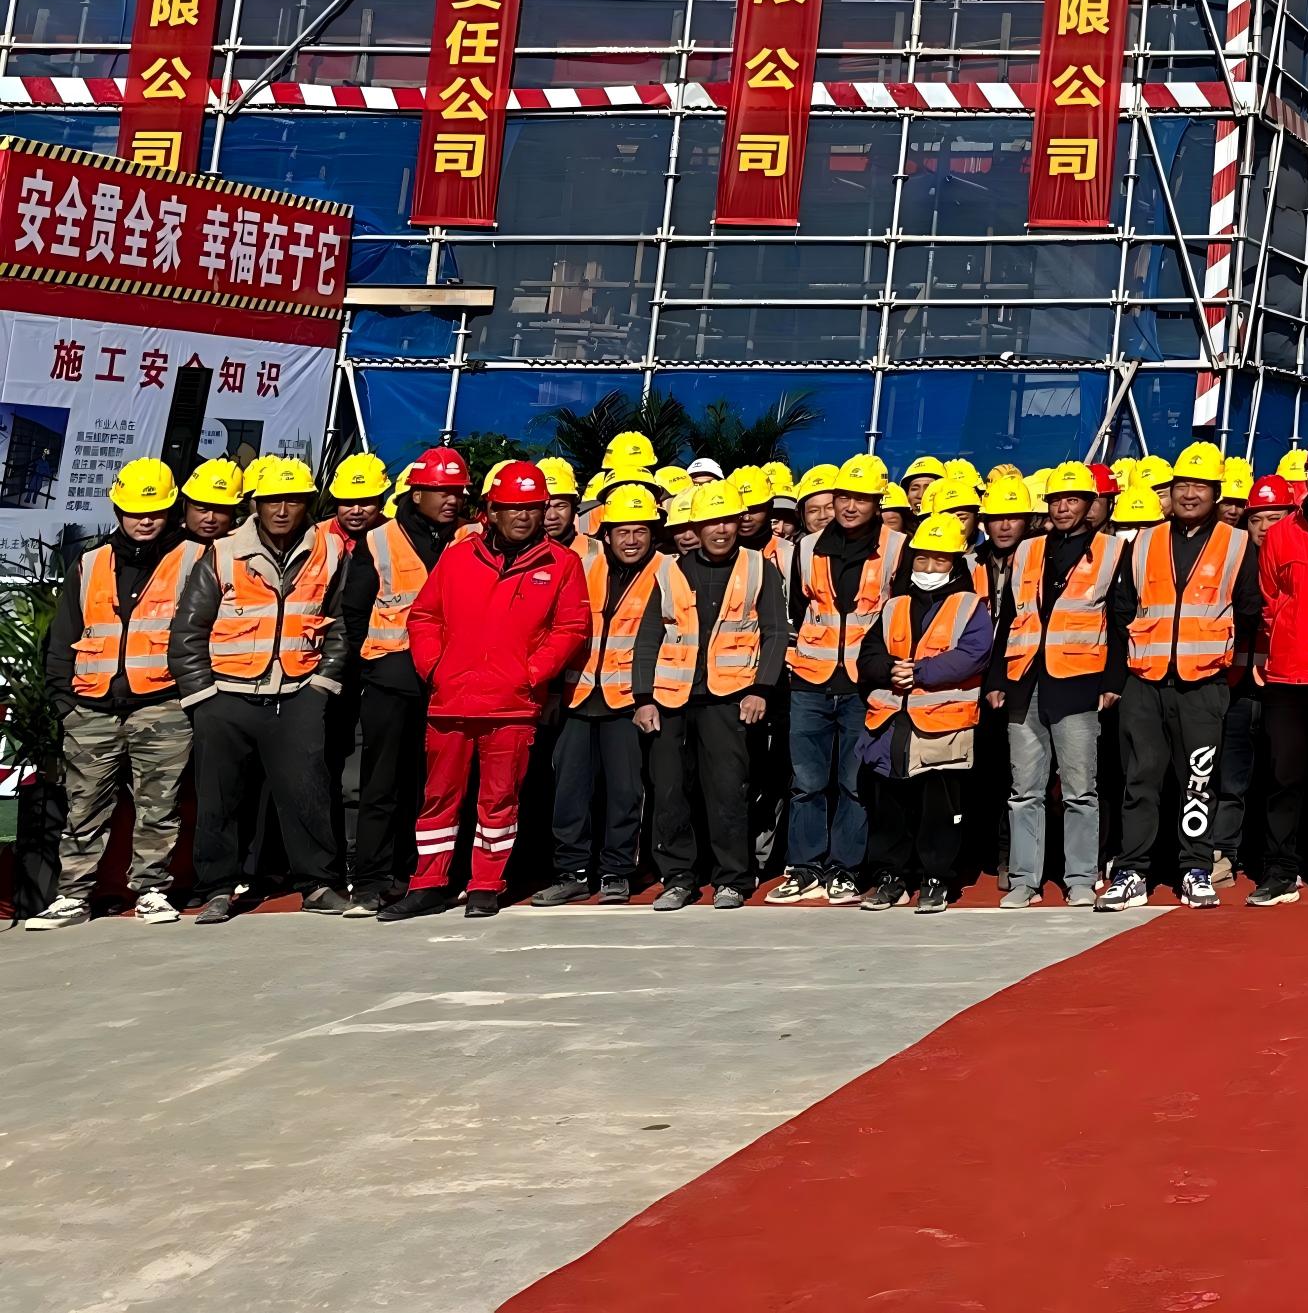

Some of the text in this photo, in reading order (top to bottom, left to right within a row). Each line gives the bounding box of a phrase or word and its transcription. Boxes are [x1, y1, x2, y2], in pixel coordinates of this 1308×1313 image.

[14, 168, 341, 296] 安全贯全家 幸福在于它
